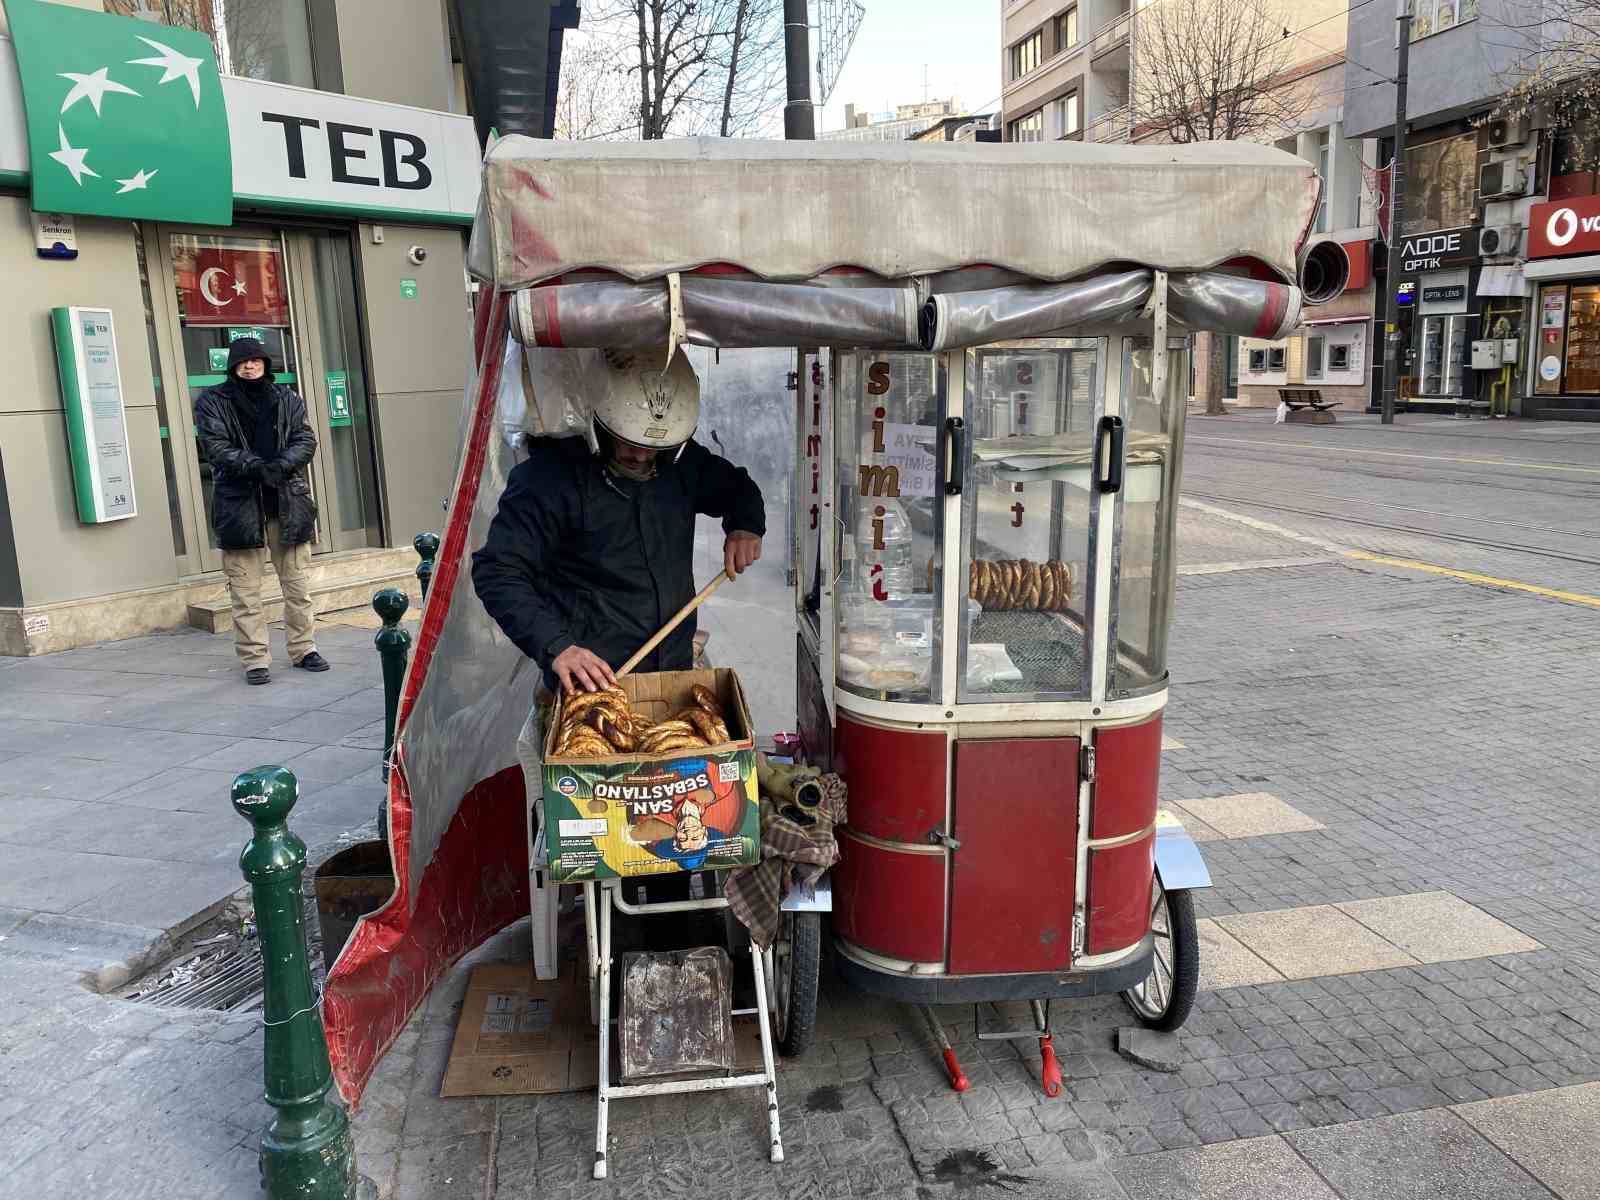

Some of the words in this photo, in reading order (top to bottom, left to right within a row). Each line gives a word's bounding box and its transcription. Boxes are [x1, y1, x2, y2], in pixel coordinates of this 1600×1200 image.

[261, 112, 432, 190] TEB
[859, 361, 901, 601] simit
[594, 773, 709, 800] SEBASTIANO
[633, 799, 673, 815] SAN
